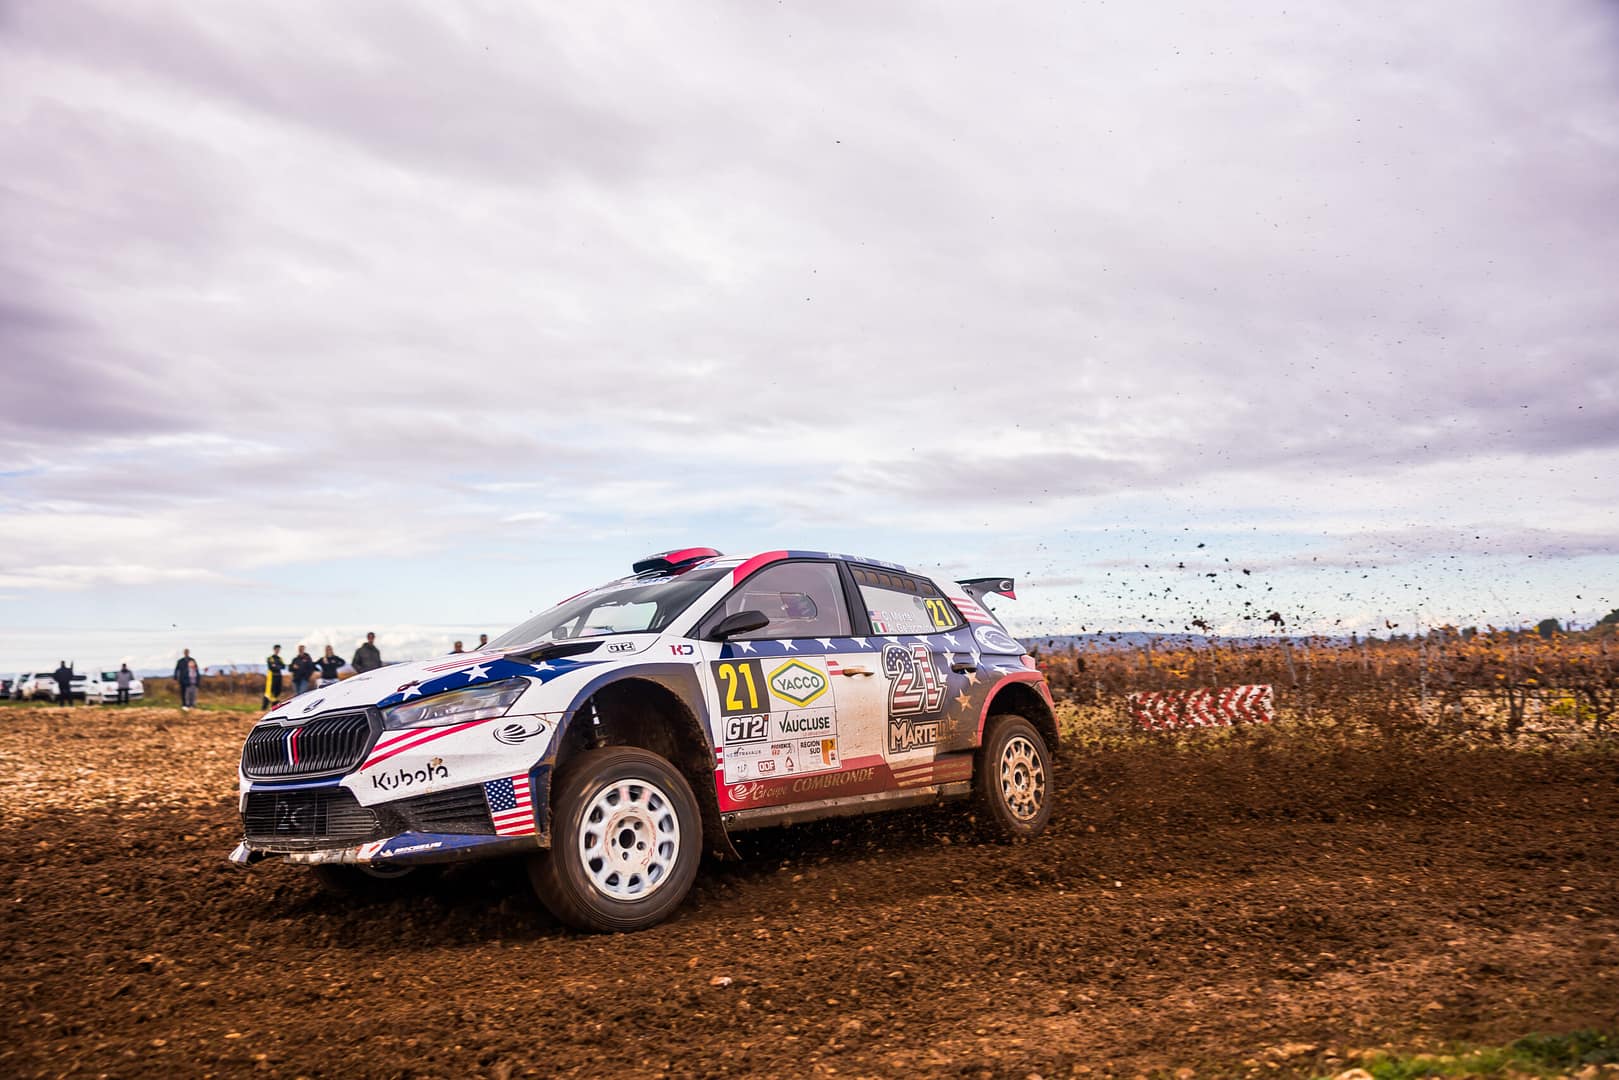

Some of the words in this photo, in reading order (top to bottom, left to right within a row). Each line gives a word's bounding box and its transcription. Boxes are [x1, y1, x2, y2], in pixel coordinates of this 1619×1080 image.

[926, 599, 954, 626] 21
[718, 663, 759, 711] 21
[777, 676, 820, 690] YACCO
[881, 643, 947, 717] 21
[726, 714, 769, 740] GT2i
[779, 712, 830, 733] VAUCLUSE
[372, 762, 449, 791] Kubota
[792, 767, 875, 793] COMBRONDE
